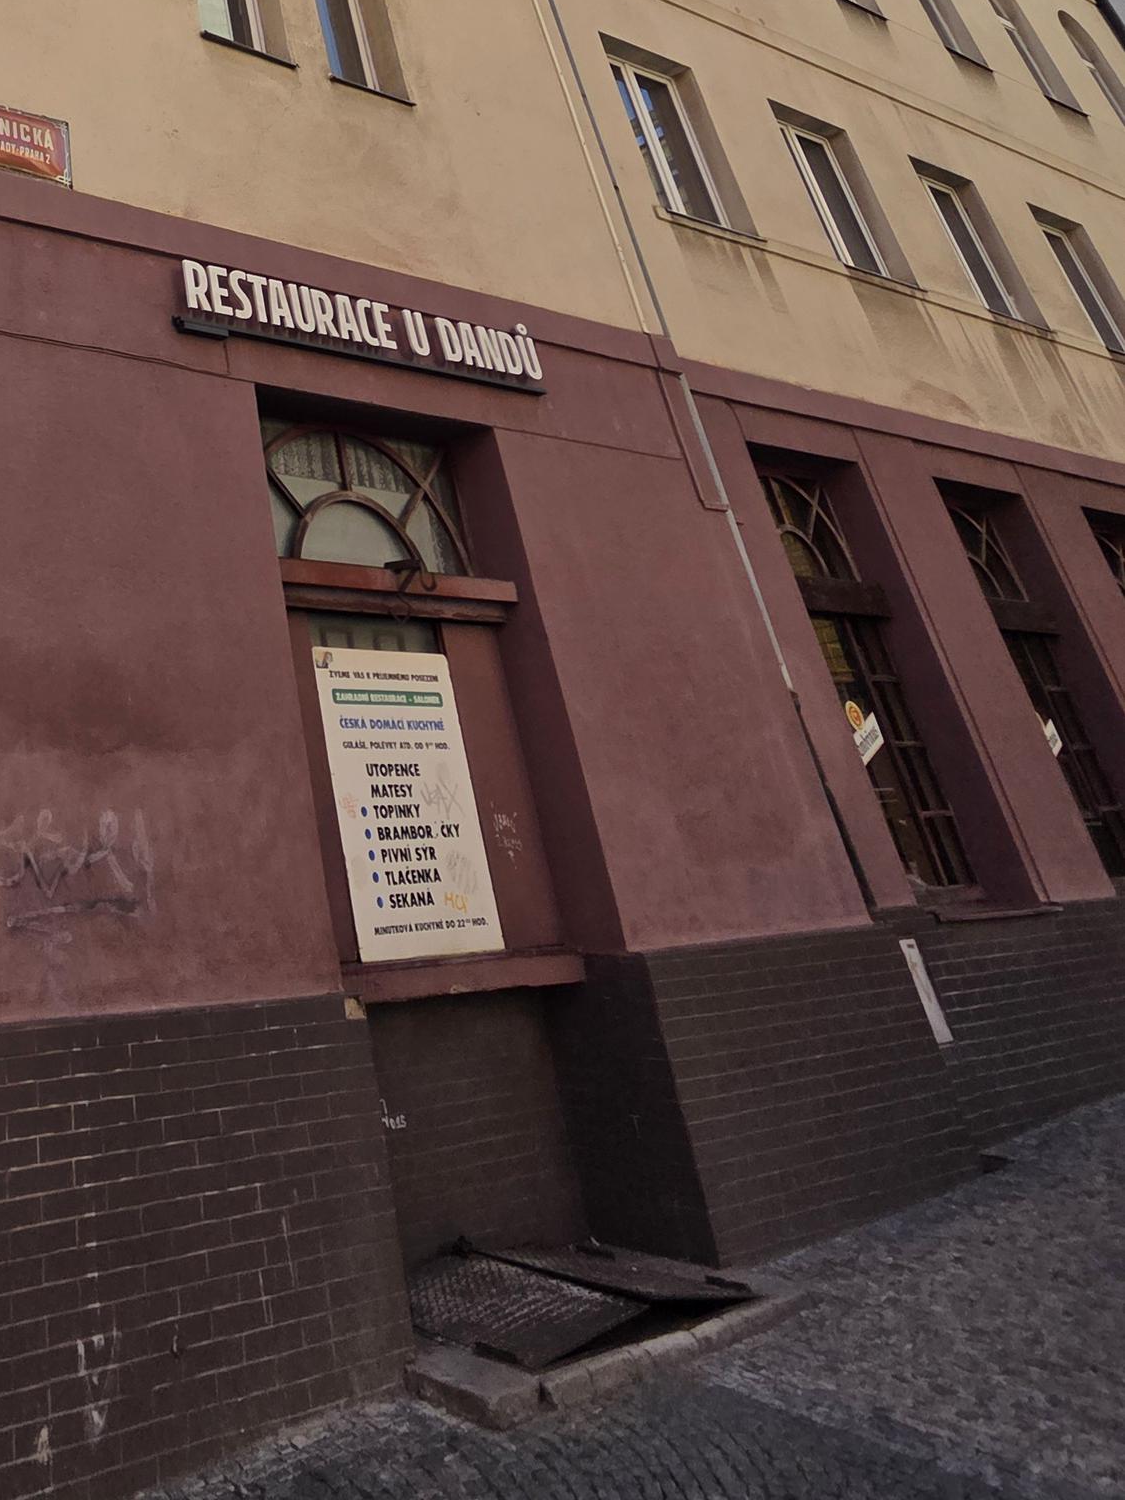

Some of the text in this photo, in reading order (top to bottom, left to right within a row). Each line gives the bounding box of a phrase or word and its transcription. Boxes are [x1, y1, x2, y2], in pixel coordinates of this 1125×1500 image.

[182, 259, 543, 380] RESTAURACE U DANDŮ
[340, 715, 367, 729] ČESKÁ
[365, 763, 421, 777] UTOPENCE
[370, 783, 413, 798] MATESY
[373, 803, 420, 819] TOPINKY
[381, 843, 437, 863] PIVNÍ SÝR
[385, 866, 442, 886] TLAČENKA
[389, 888, 435, 909] SEKANÁ
[446, 920, 456, 929] DO
